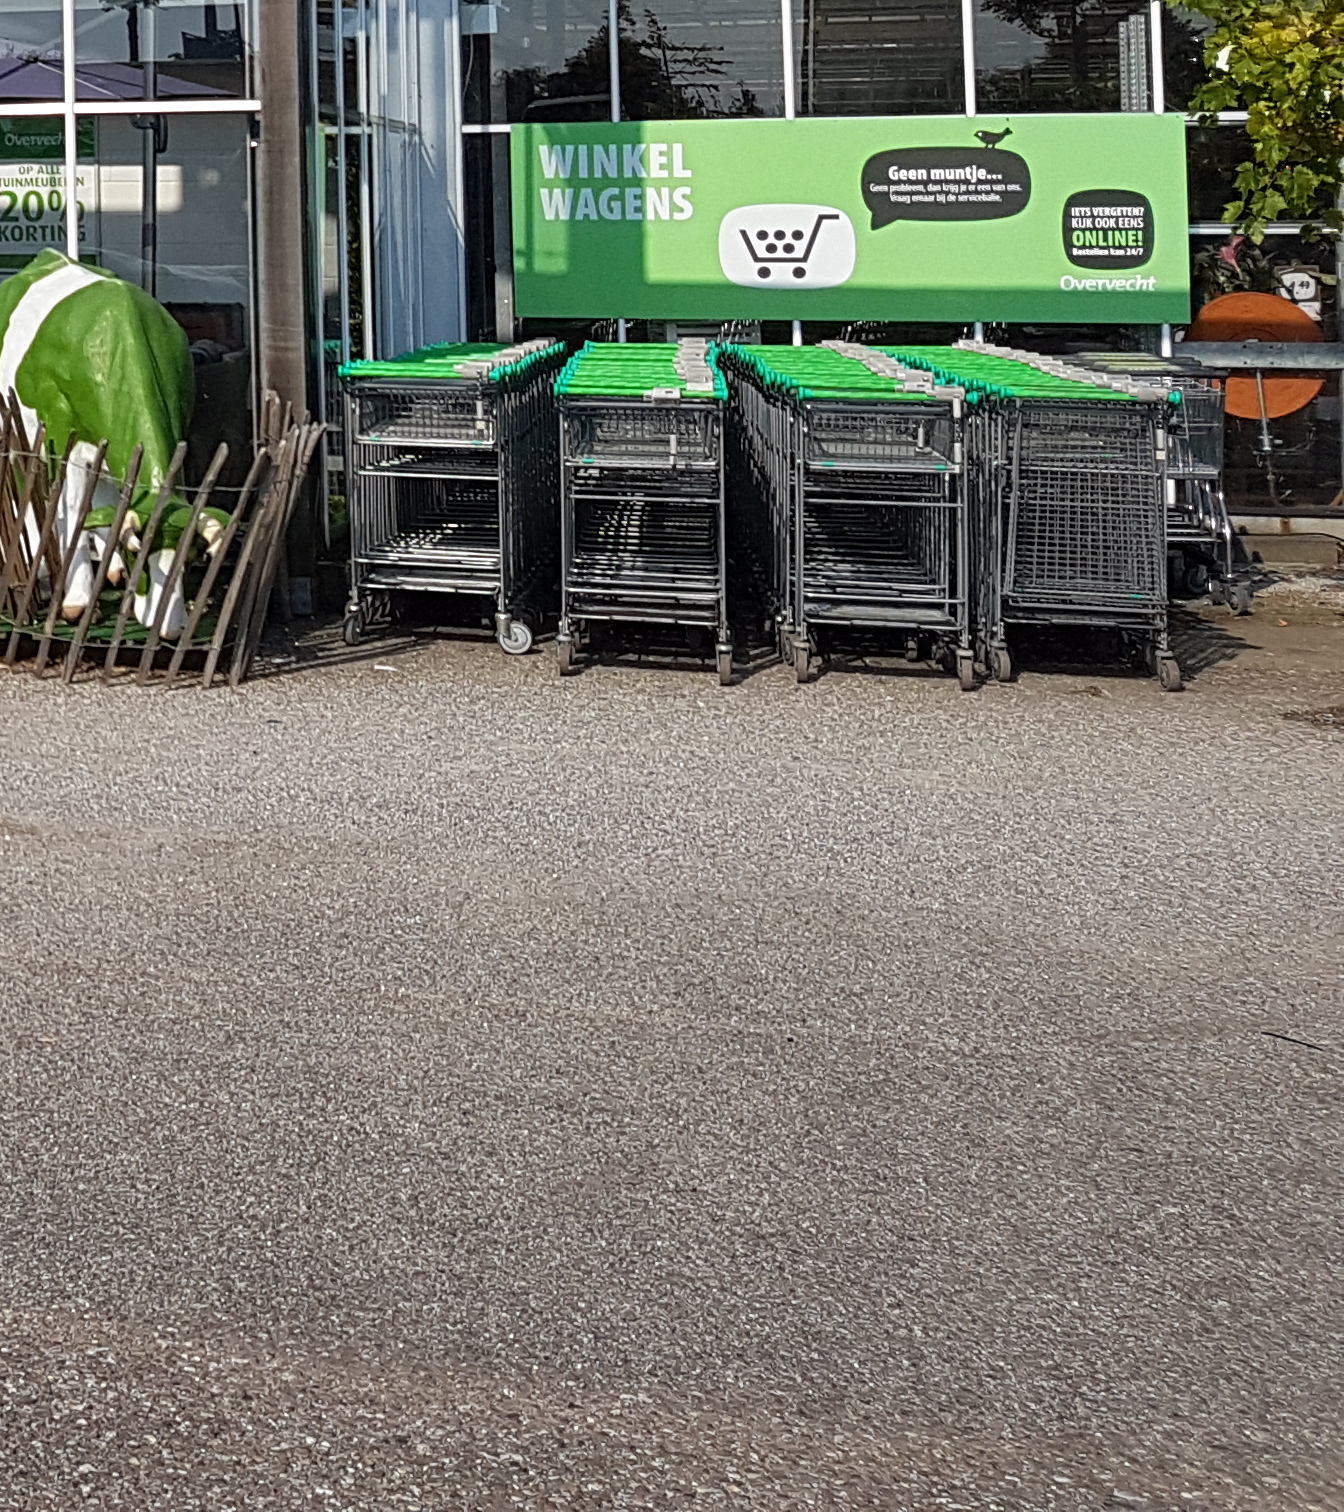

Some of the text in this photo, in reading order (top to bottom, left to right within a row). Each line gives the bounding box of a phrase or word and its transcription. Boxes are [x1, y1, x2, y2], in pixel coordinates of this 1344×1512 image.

[538, 143, 692, 179] WINKEL
[18, 166, 62, 175] OP ALLE
[888, 165, 1003, 183] Geen muntje...
[539, 186, 694, 221] WAGENS
[1071, 206, 1145, 216] IETS VERGETEN?
[1071, 217, 1144, 228] KIJK OOK EENS
[1072, 230, 1143, 247] ONLINE!
[1060, 274, 1157, 291] Overvecht
